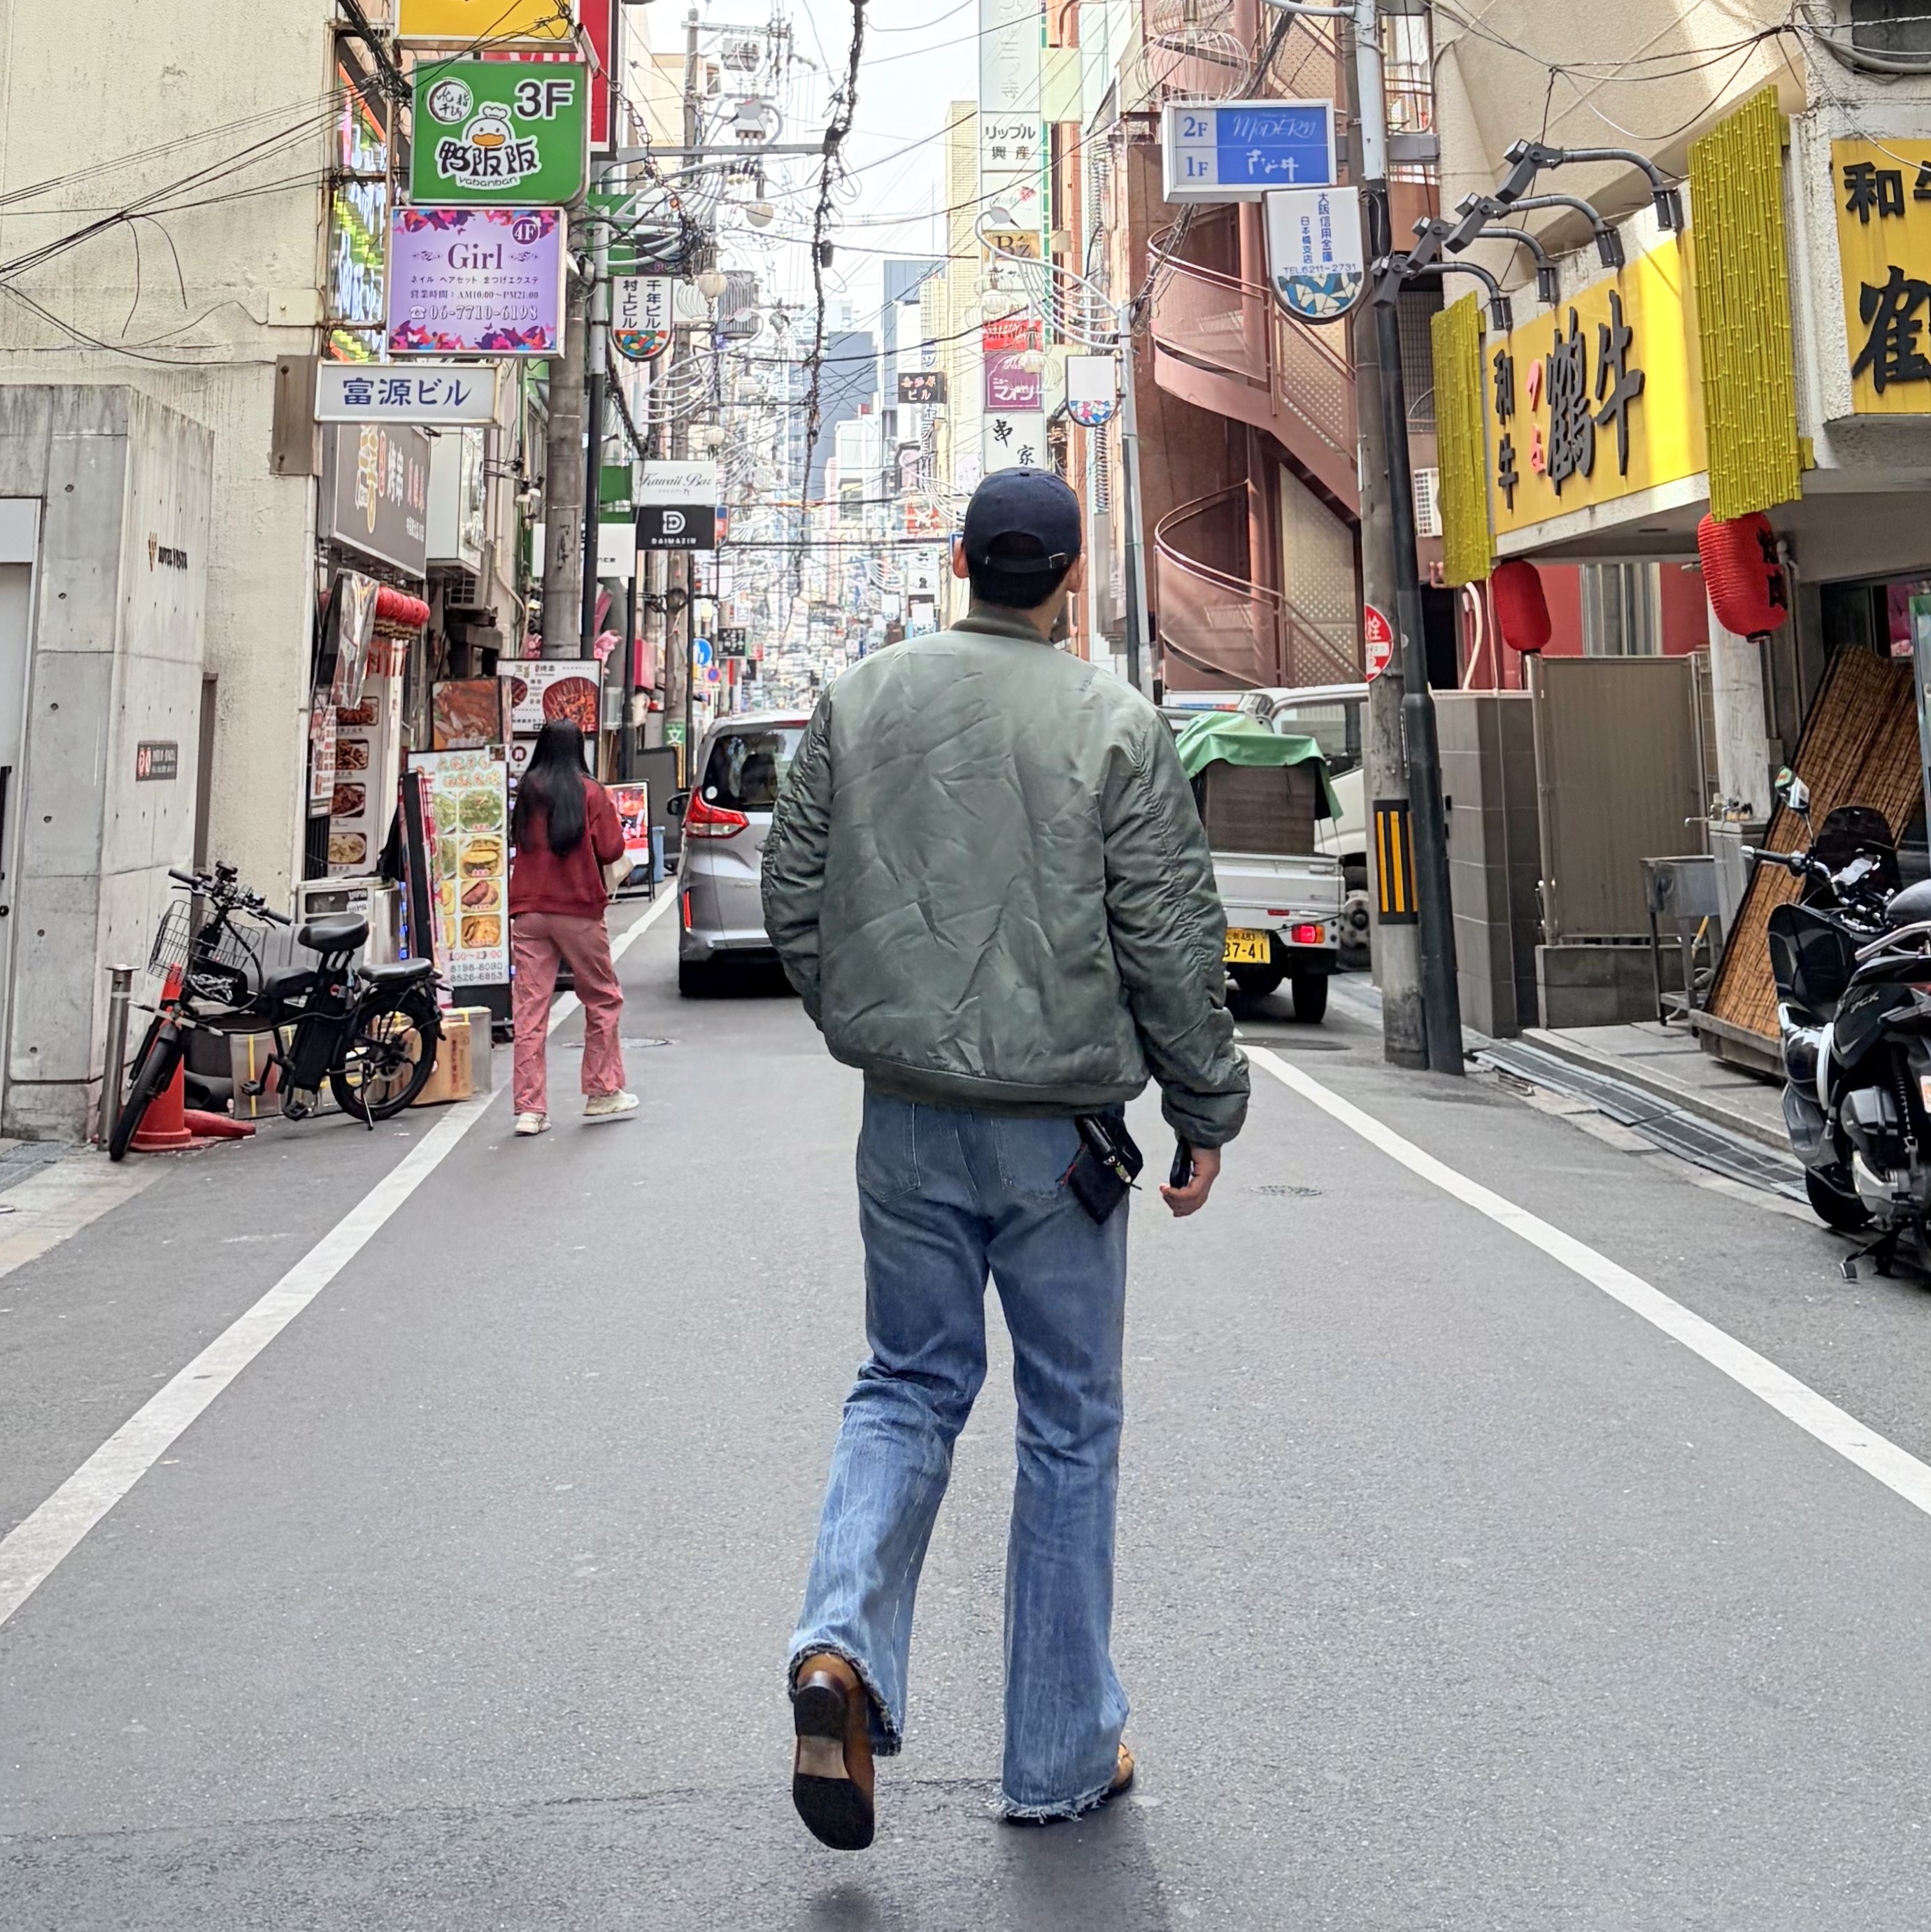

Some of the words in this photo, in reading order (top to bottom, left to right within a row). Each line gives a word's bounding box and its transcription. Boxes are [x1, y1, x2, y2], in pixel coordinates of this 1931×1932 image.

[516, 81, 572, 118] 3F
[985, 124, 1036, 140] リップル
[1183, 117, 1208, 137] 2F
[992, 145, 1032, 160] 興産
[1185, 156, 1209, 177] 1F
[459, 176, 518, 188] yabanban
[514, 225, 537, 241] 4F
[1318, 192, 1333, 262] 大阪信用金庫
[1301, 215, 1313, 264] 日本橋支店
[448, 243, 504, 270] Girl
[411, 276, 434, 284] ネイル
[440, 276, 478, 284] ヘアセット
[429, 304, 539, 321] 06-7710-6198
[622, 280, 638, 329] 村上ビル
[646, 280, 662, 329] 千年ビル
[343, 377, 472, 406] 富源ビル
[908, 389, 932, 401] ビル
[1493, 349, 1519, 514] 和牛
[683, 471, 712, 487] Bar
